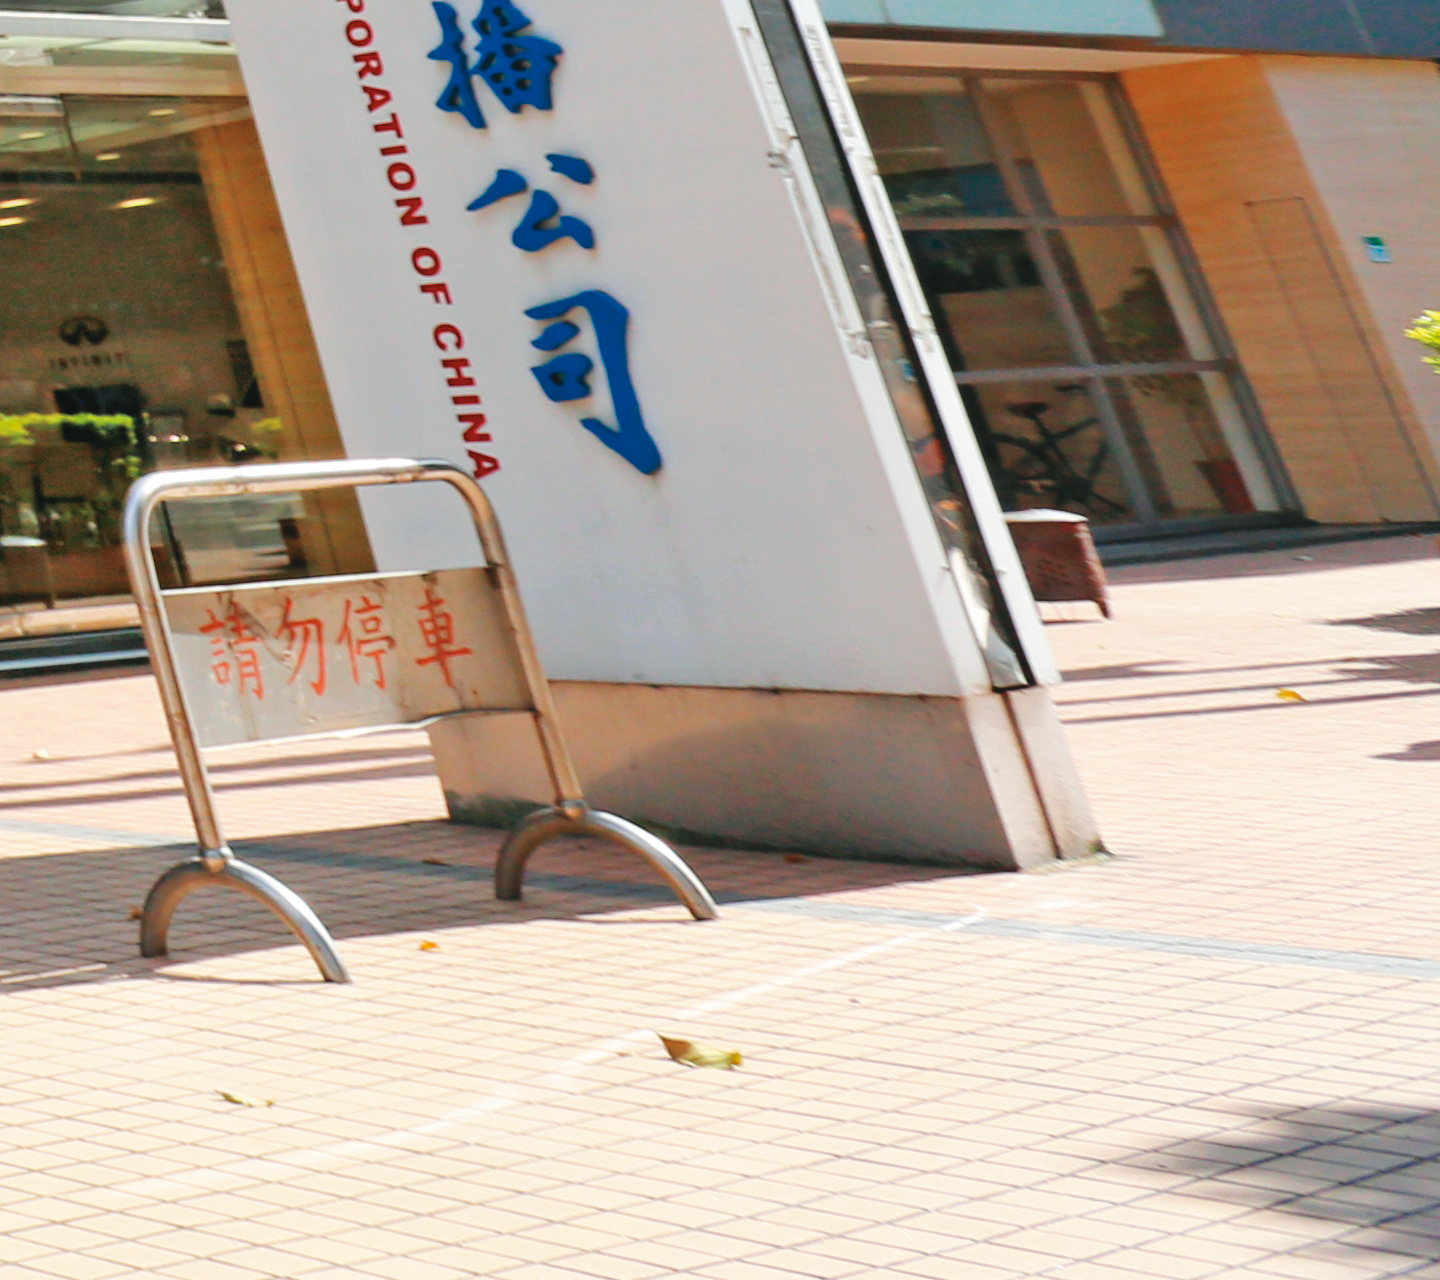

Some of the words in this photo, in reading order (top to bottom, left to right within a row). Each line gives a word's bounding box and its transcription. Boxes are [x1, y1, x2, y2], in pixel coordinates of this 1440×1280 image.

[410, 246, 454, 306] OF
[432, 322, 503, 480] CHINA
[198, 590, 473, 701] 請勿停車
